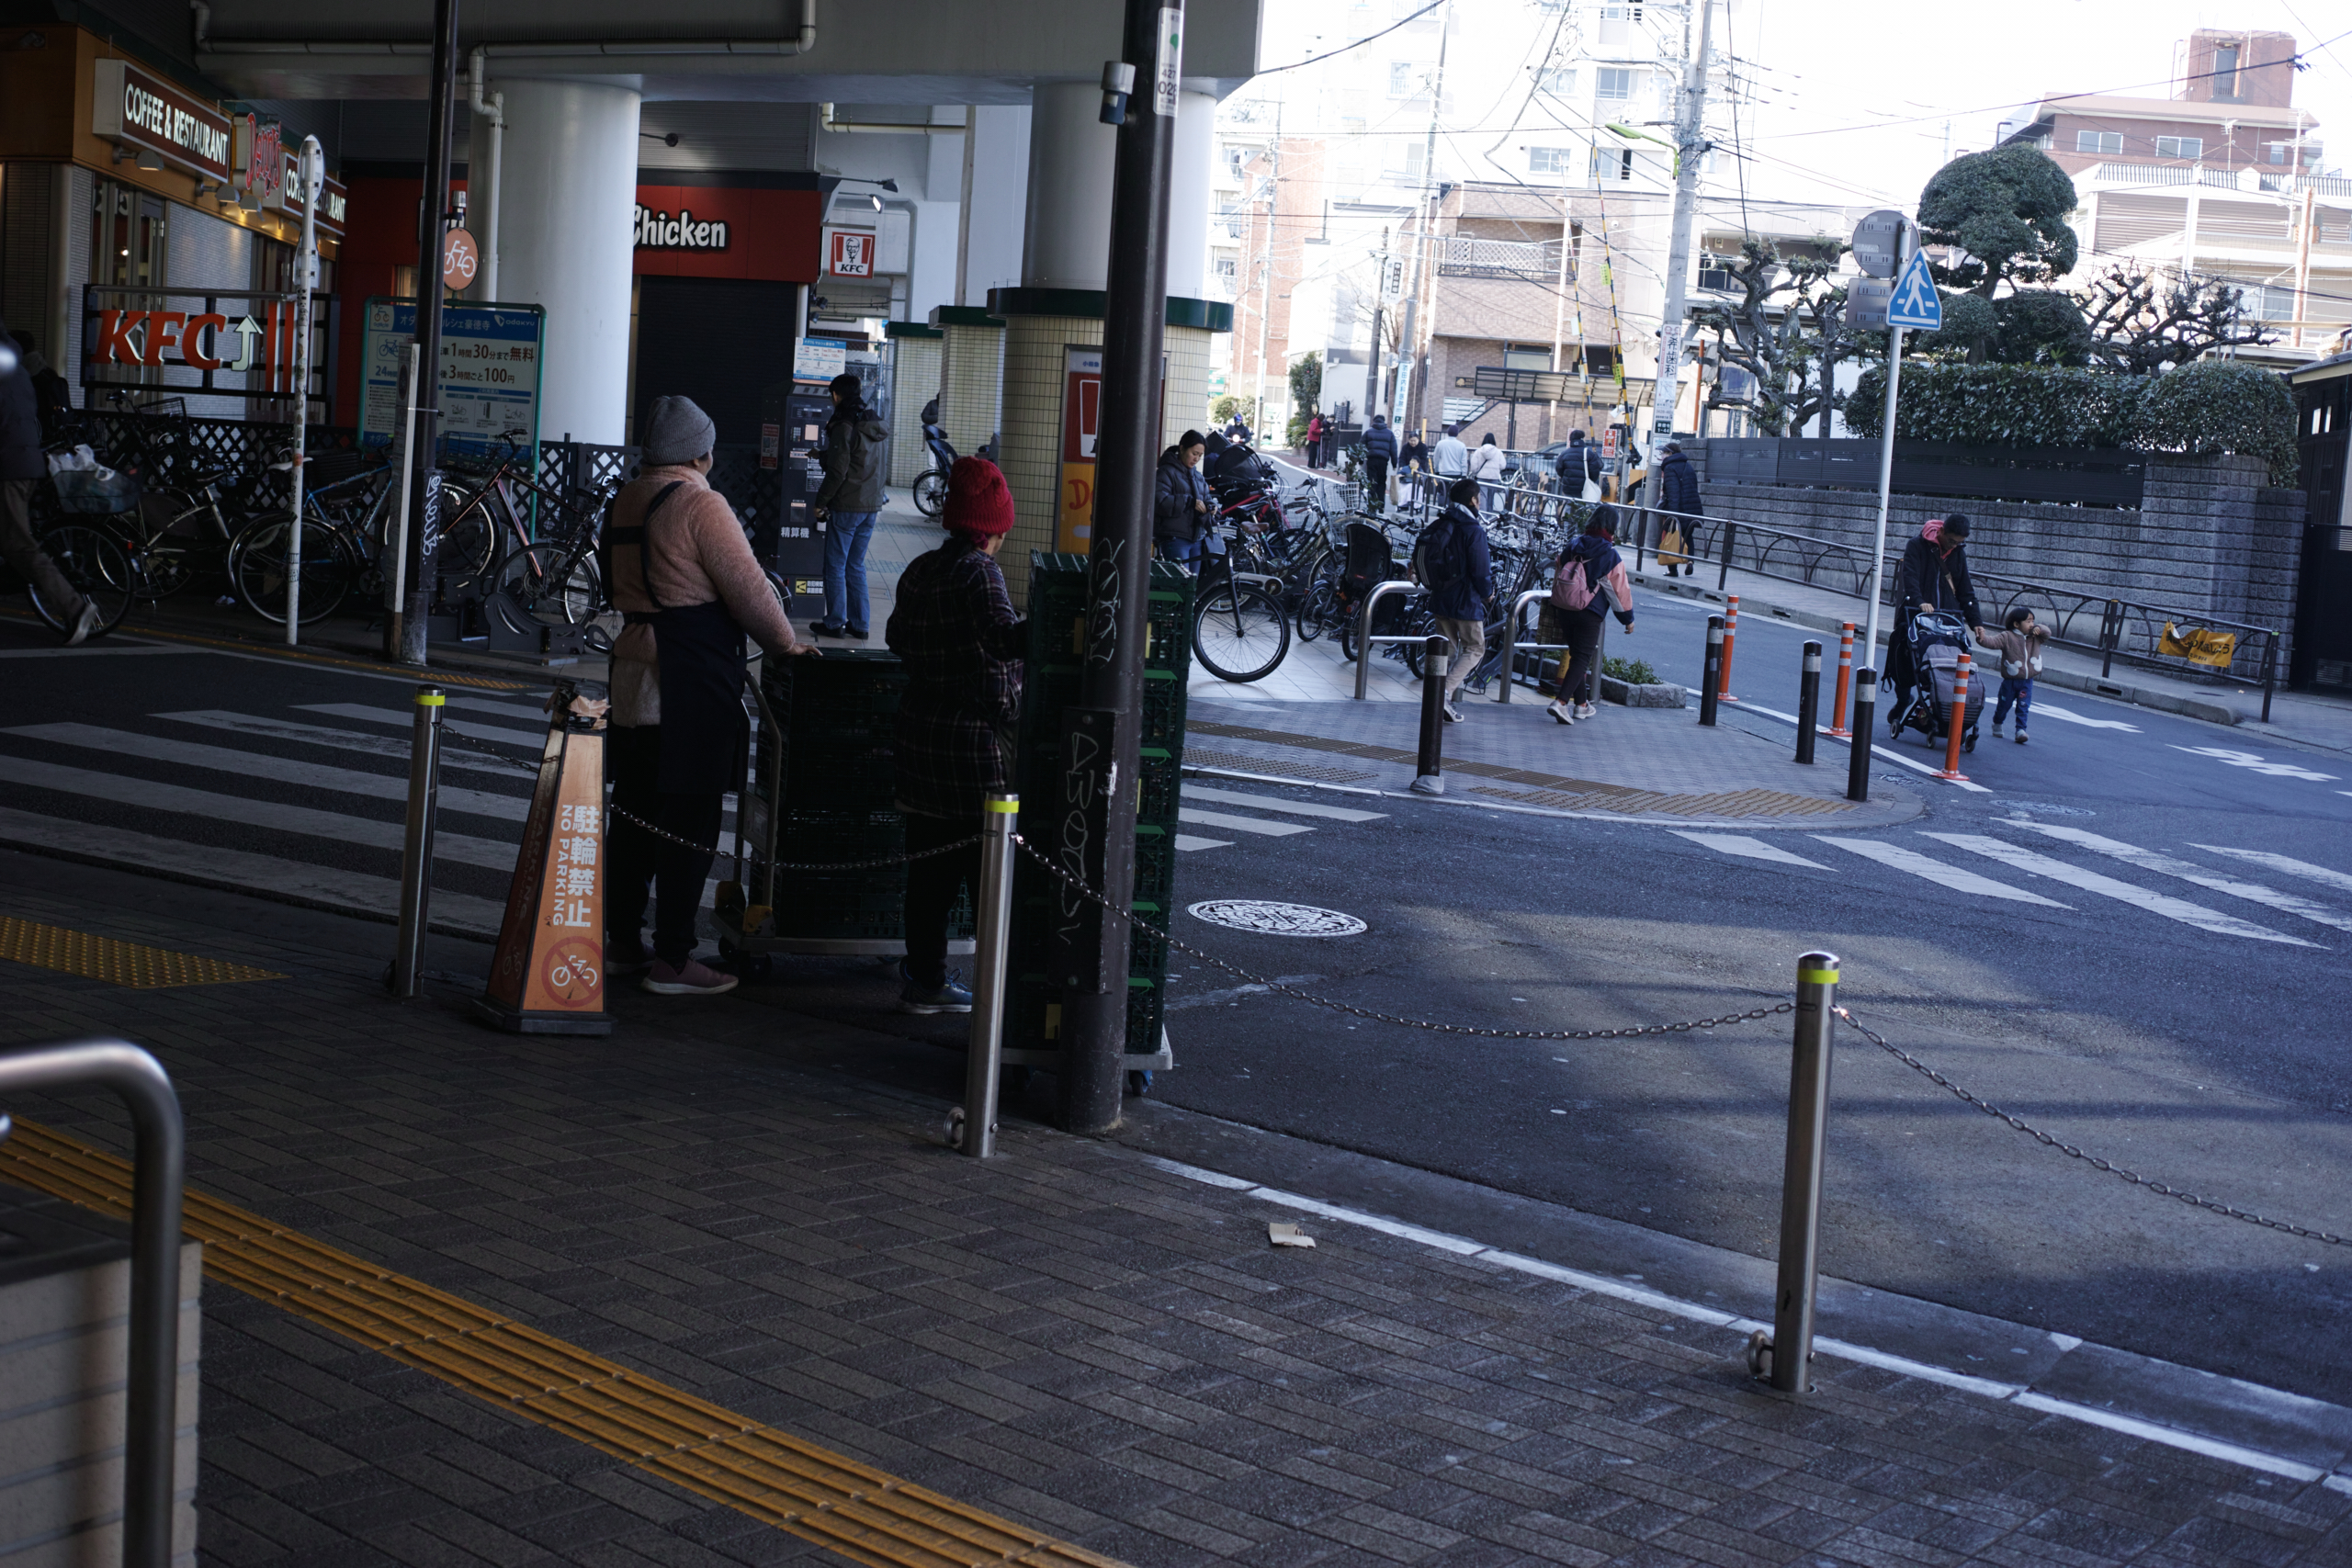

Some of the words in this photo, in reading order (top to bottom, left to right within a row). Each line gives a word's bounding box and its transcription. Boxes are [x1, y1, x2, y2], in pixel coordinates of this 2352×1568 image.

[125, 83, 164, 136] COFFEE
[164, 103, 173, 140] &
[174, 107, 229, 166] RESTAURANT
[840, 263, 864, 274] KFC
[92, 309, 228, 371] KFC
[781, 526, 810, 539] 精算機
[560, 804, 573, 831] NO
[552, 838, 571, 926] PARKING
[564, 805, 600, 928] 駐輪禁止
